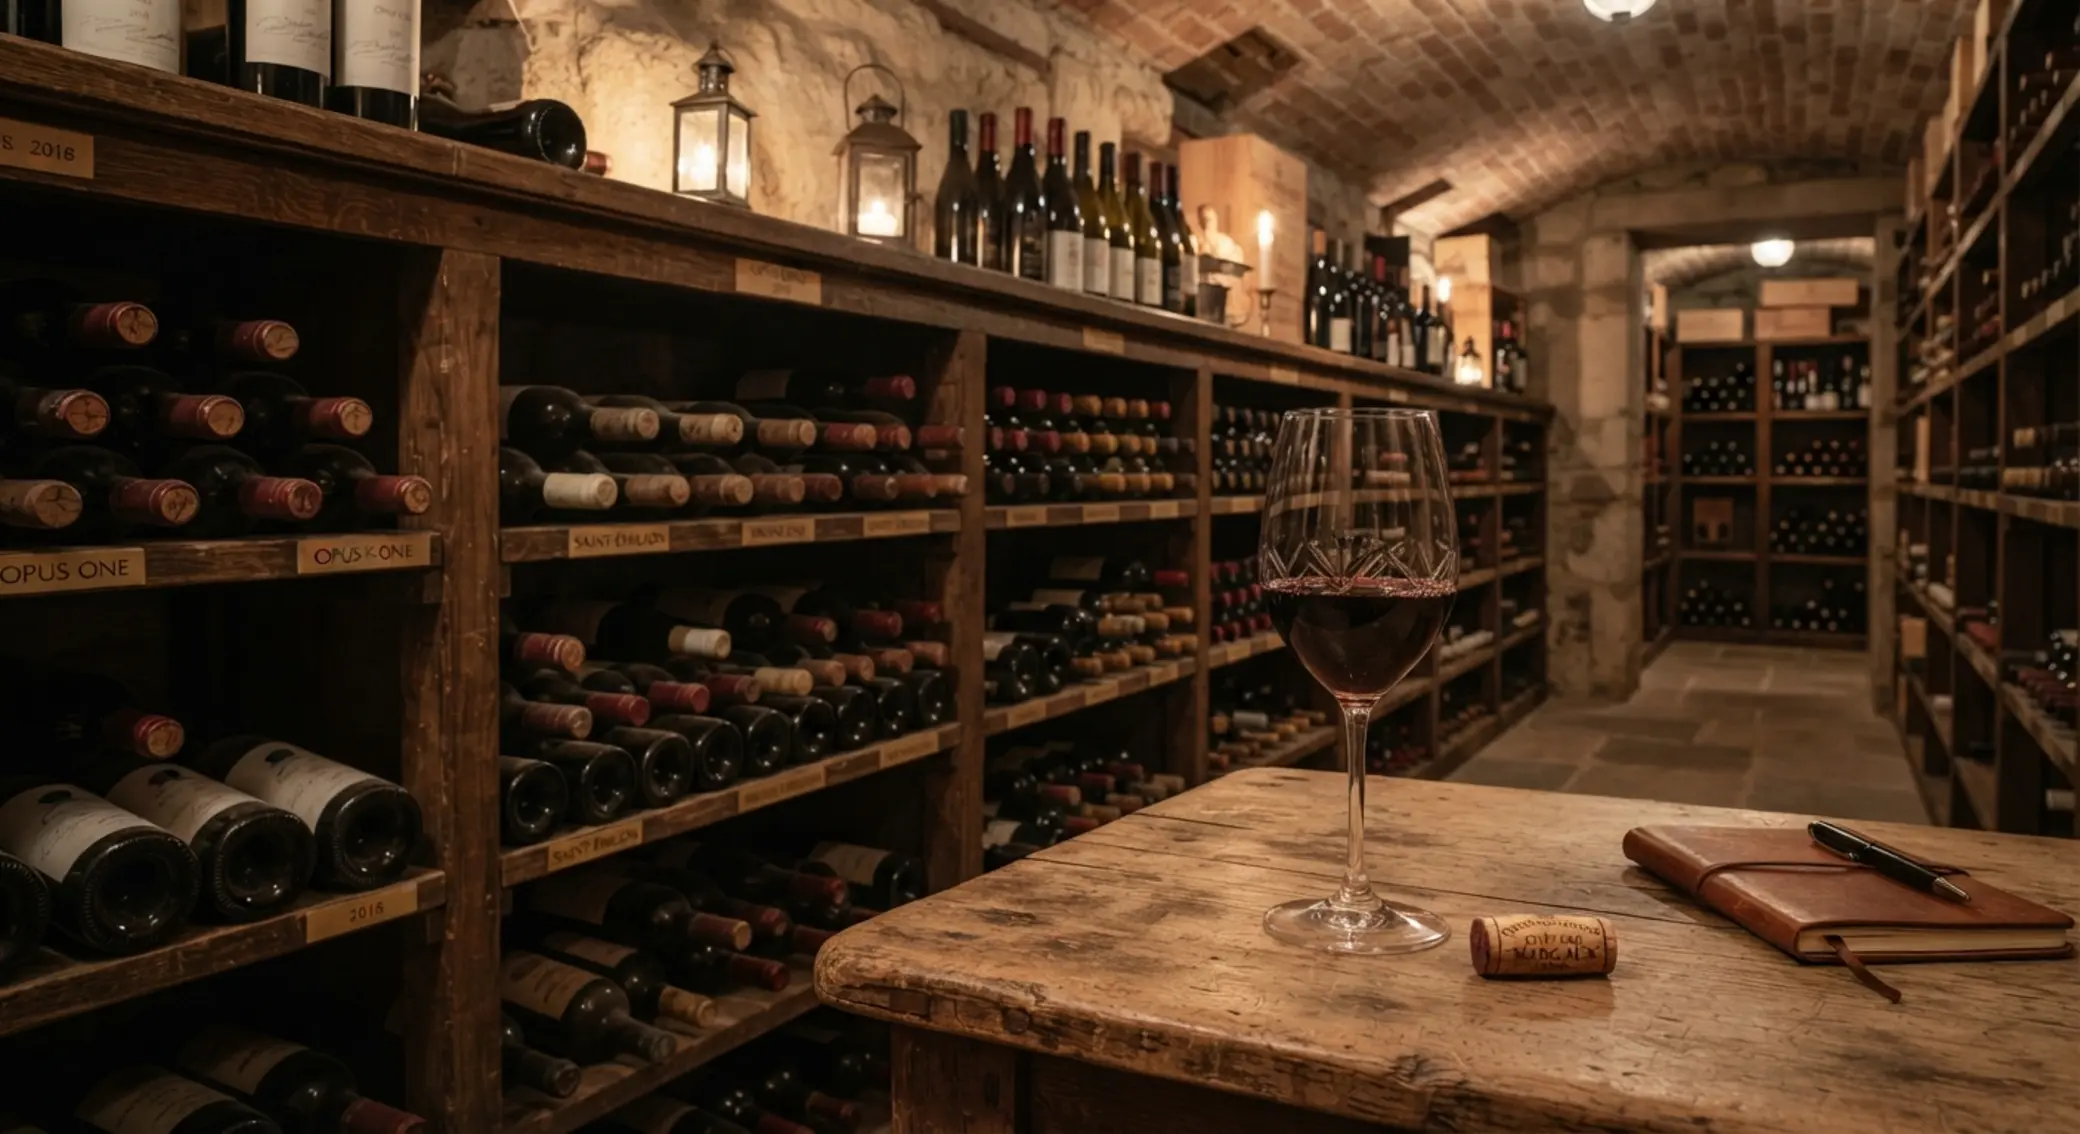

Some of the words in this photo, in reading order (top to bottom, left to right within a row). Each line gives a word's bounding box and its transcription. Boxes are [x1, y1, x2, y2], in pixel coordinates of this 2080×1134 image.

[30, 140, 75, 161] 2016
[0, 562, 70, 583] OPUS
[79, 560, 128, 579] ONE
